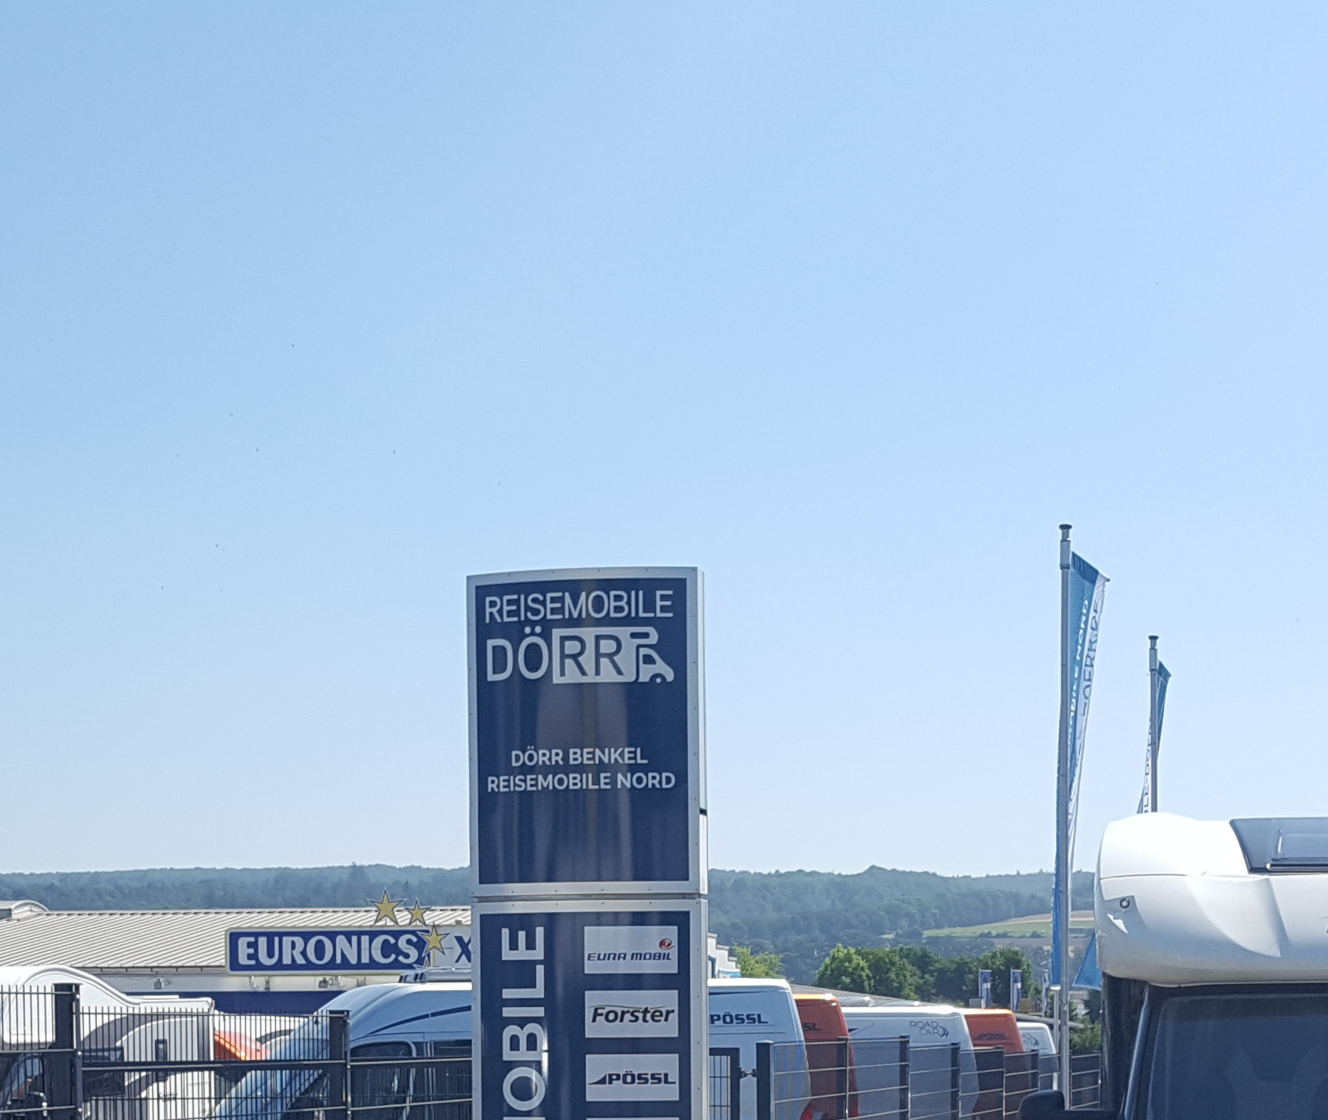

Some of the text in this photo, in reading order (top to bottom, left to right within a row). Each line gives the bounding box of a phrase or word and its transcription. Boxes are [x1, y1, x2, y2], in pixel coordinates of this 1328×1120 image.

[485, 590, 673, 623] REISEMOBILE
[486, 626, 625, 682] DÖRR
[511, 746, 648, 767] DÖRR BENKEL
[487, 772, 675, 792] REISEMOBILE NORD
[237, 934, 419, 966] EURONICS
[587, 951, 672, 961] EURA MOBIL
[591, 1007, 674, 1023] Forster
[709, 1012, 769, 1025] PÖSSL
[910, 1021, 938, 1029] ROAD
[919, 1028, 940, 1036] CAR
[608, 1071, 676, 1085] PÖSSL
